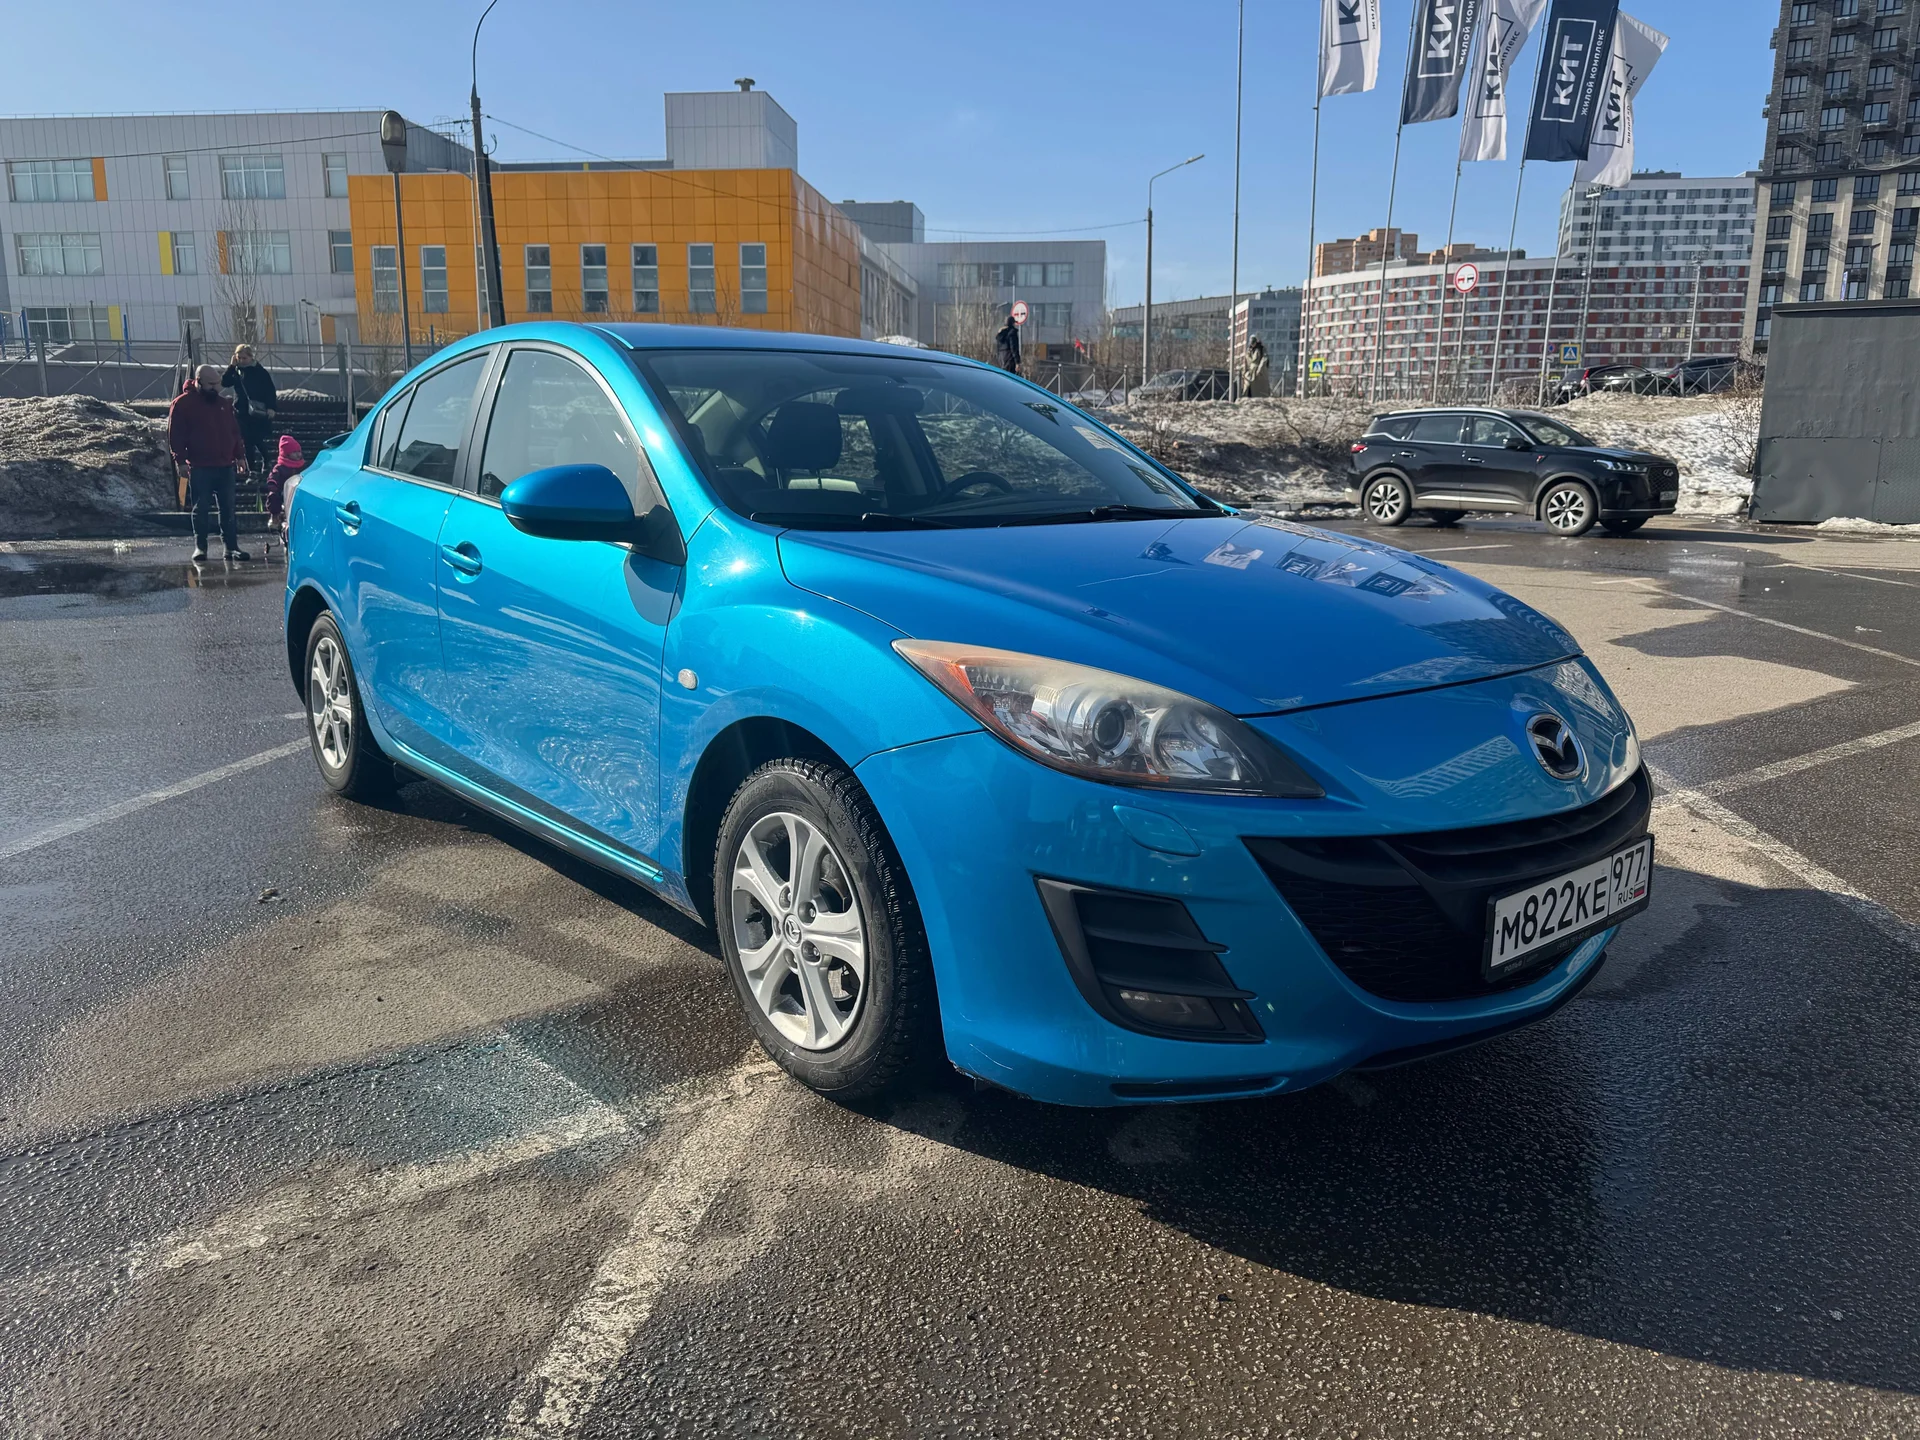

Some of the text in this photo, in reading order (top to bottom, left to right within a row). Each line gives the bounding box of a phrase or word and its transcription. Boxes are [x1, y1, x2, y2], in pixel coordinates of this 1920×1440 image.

[1458, 27, 1471, 66] жилой
[1485, 34, 1501, 100] КИ
[1552, 34, 1584, 106] КИТ
[1580, 28, 1605, 116] жилой комплекс
[1602, 70, 1623, 132] КИТ
[1613, 845, 1646, 893] 977
[1616, 886, 1634, 907] RUS
[1499, 874, 1608, 956] М822КЕ
